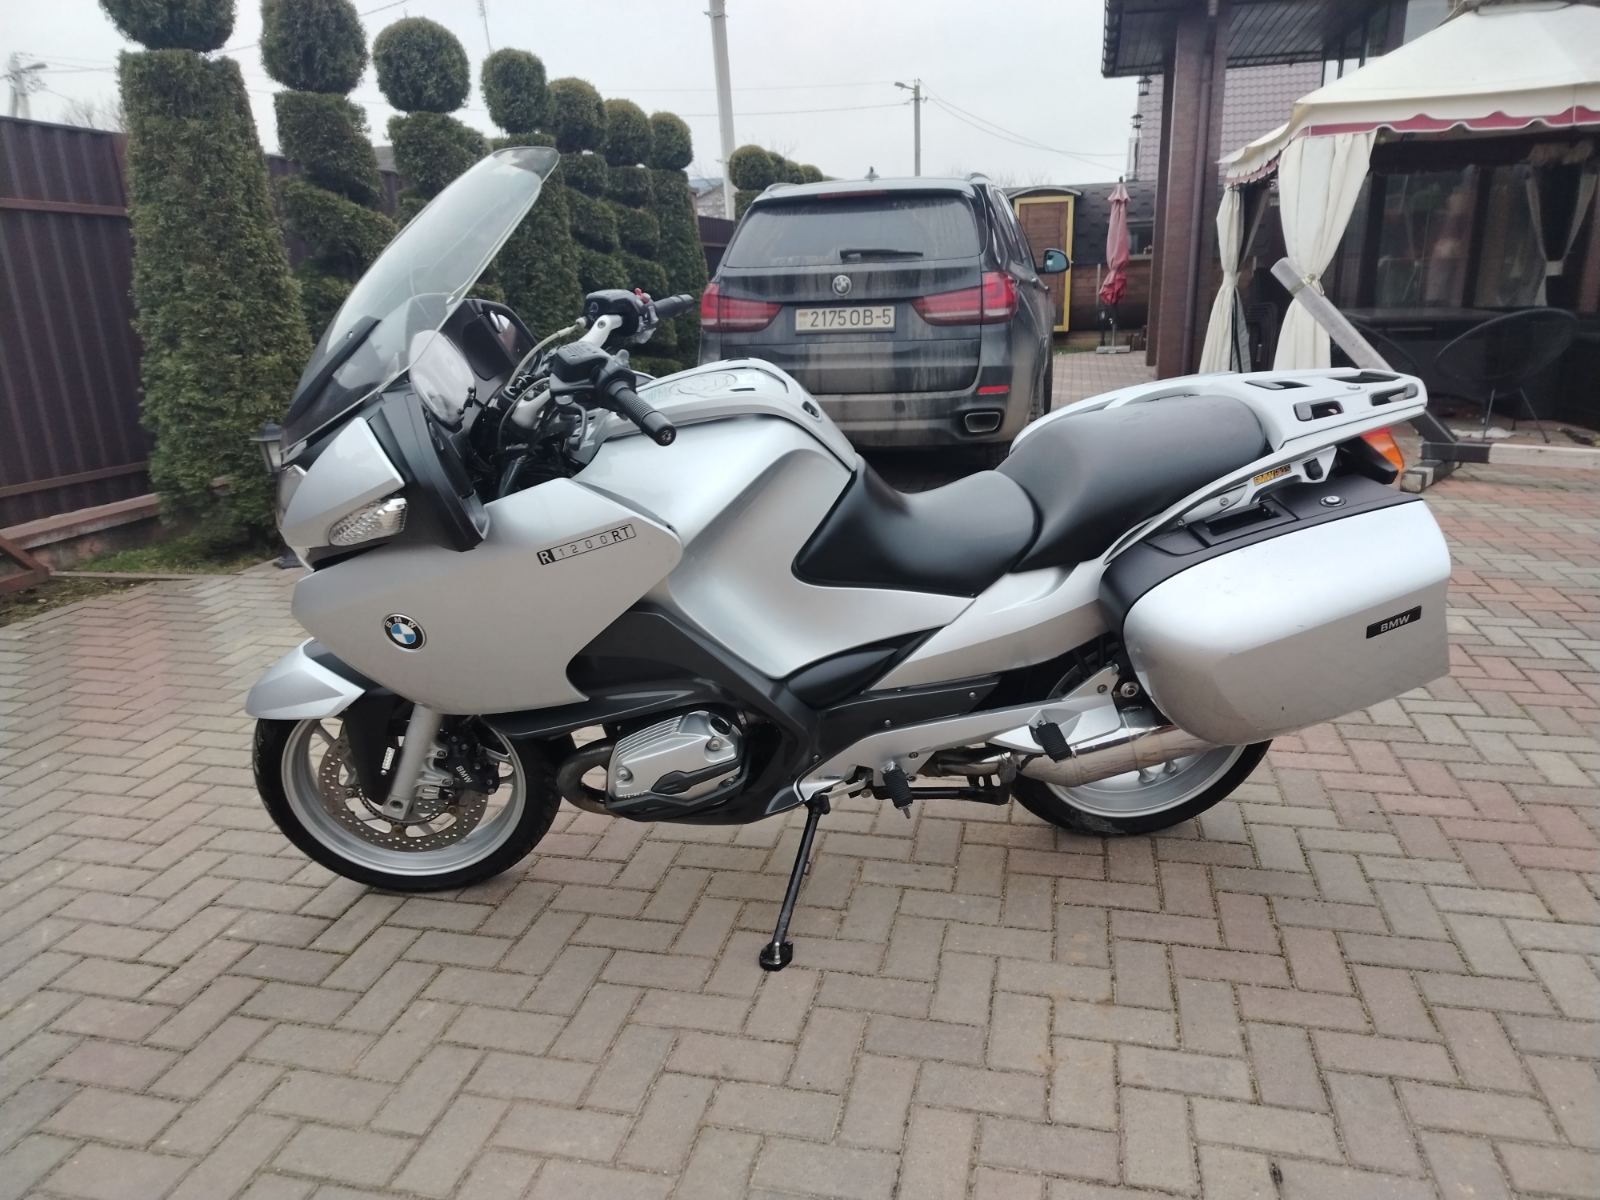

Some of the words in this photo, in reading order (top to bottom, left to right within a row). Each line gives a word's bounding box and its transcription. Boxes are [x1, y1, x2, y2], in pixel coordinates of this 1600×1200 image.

[385, 616, 417, 629] BMW
[1380, 614, 1410, 632] BMW
[456, 765, 473, 783] BMW
